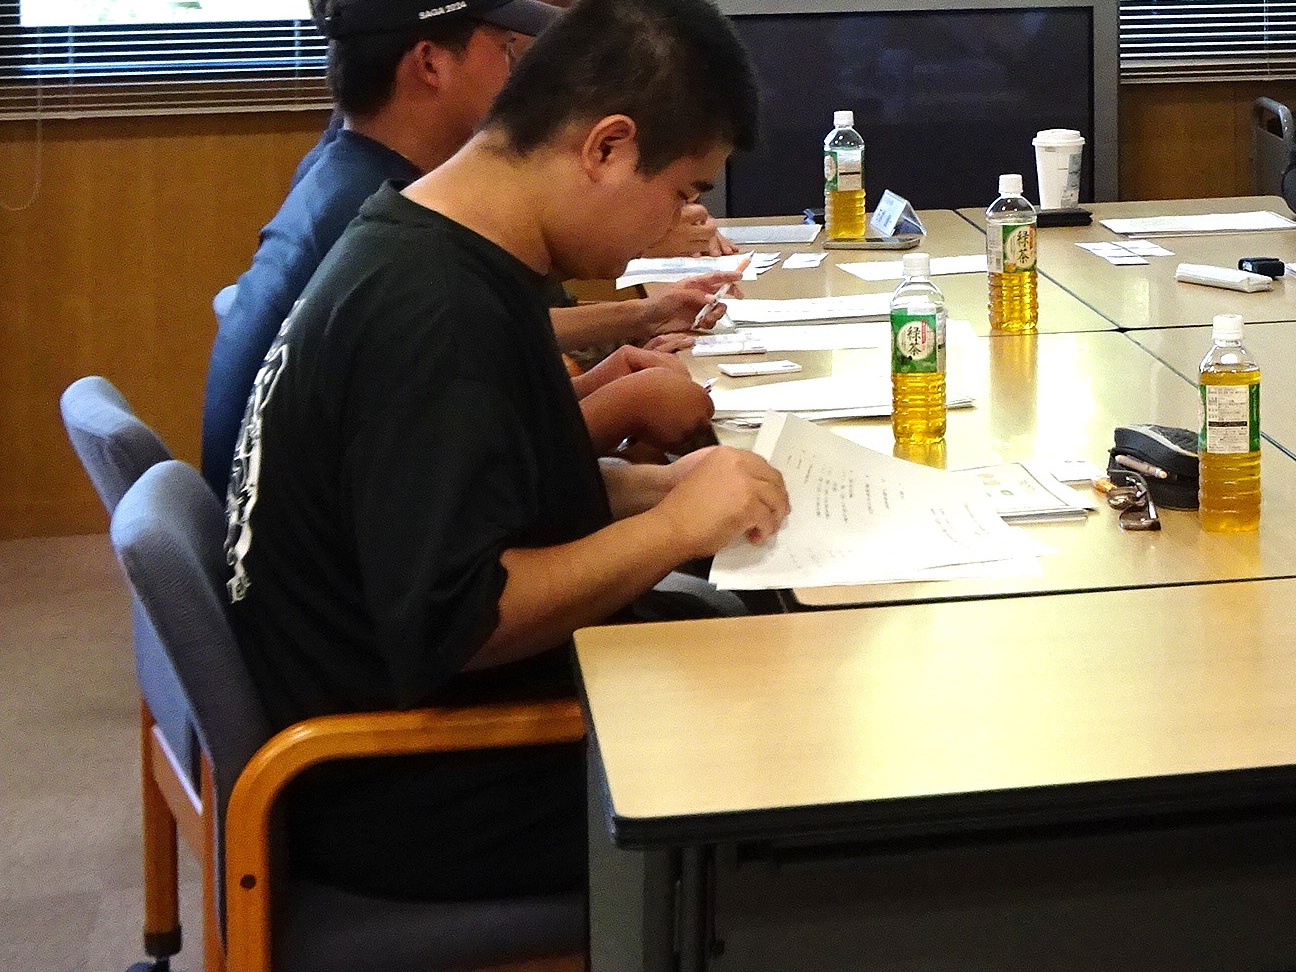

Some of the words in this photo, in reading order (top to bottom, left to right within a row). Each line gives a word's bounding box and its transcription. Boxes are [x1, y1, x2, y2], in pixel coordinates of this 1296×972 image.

[418, 7, 445, 20] SAGA
[445, 0, 467, 13] 2024
[1016, 230, 1029, 264] 緑茶
[906, 326, 921, 356] 緑茶
